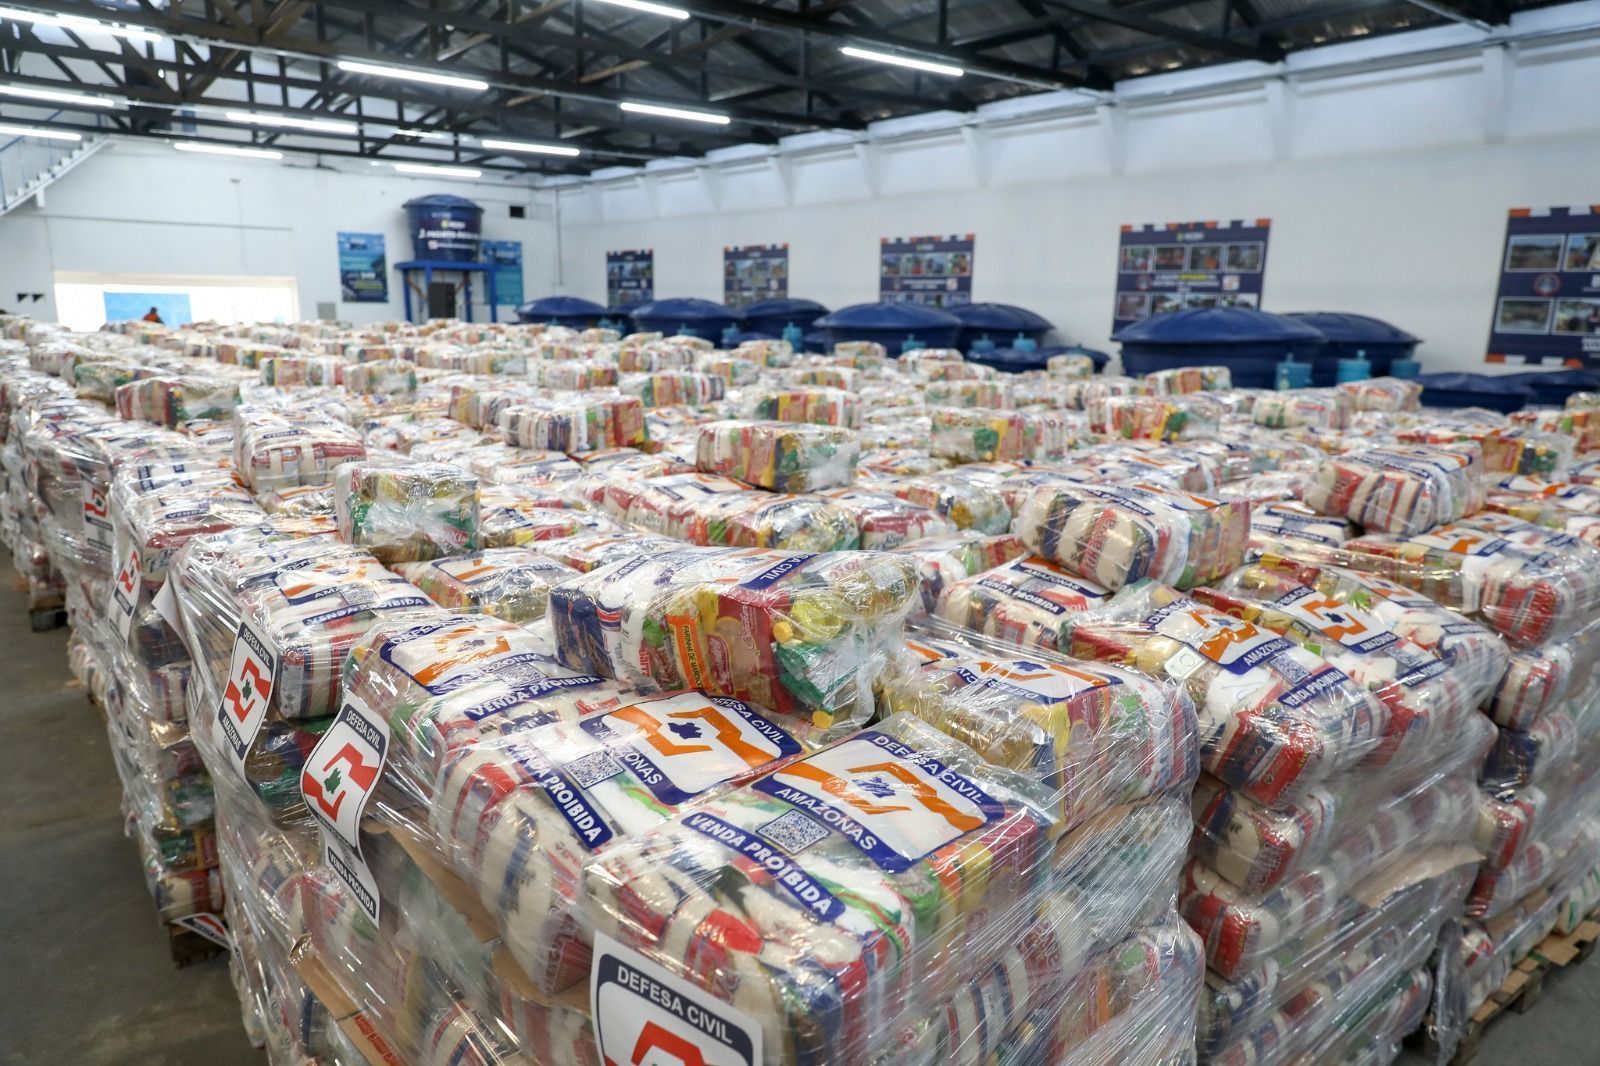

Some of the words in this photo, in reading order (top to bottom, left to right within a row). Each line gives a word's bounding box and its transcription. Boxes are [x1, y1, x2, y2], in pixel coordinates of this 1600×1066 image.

[761, 561, 793, 581] CIVIL
[1024, 568, 1081, 590] AMAZONAS
[361, 597, 424, 611] POIBIDA
[1013, 590, 1060, 614] PROIBIDA
[243, 628, 261, 654] DEFESA
[1243, 638, 1290, 667] AMAZONAS
[690, 660, 705, 689] MANDIOC
[472, 688, 532, 718] VENDA
[531, 675, 601, 696] PROIBIDA
[346, 710, 367, 738] DEFESA
[366, 729, 380, 749] CIVIL
[751, 718, 782, 745] CIVIL
[599, 728, 663, 788] AZONAS
[872, 734, 939, 776] DEFESA
[936, 770, 983, 805] CIVIL
[548, 773, 603, 843] PROIBIDA
[774, 785, 878, 852] AMAZONAS
[690, 815, 747, 848] VENDA
[743, 841, 834, 916] PROIBIDA
[617, 964, 684, 1017] DEFESA
[686, 1006, 734, 1045] CIVIL
